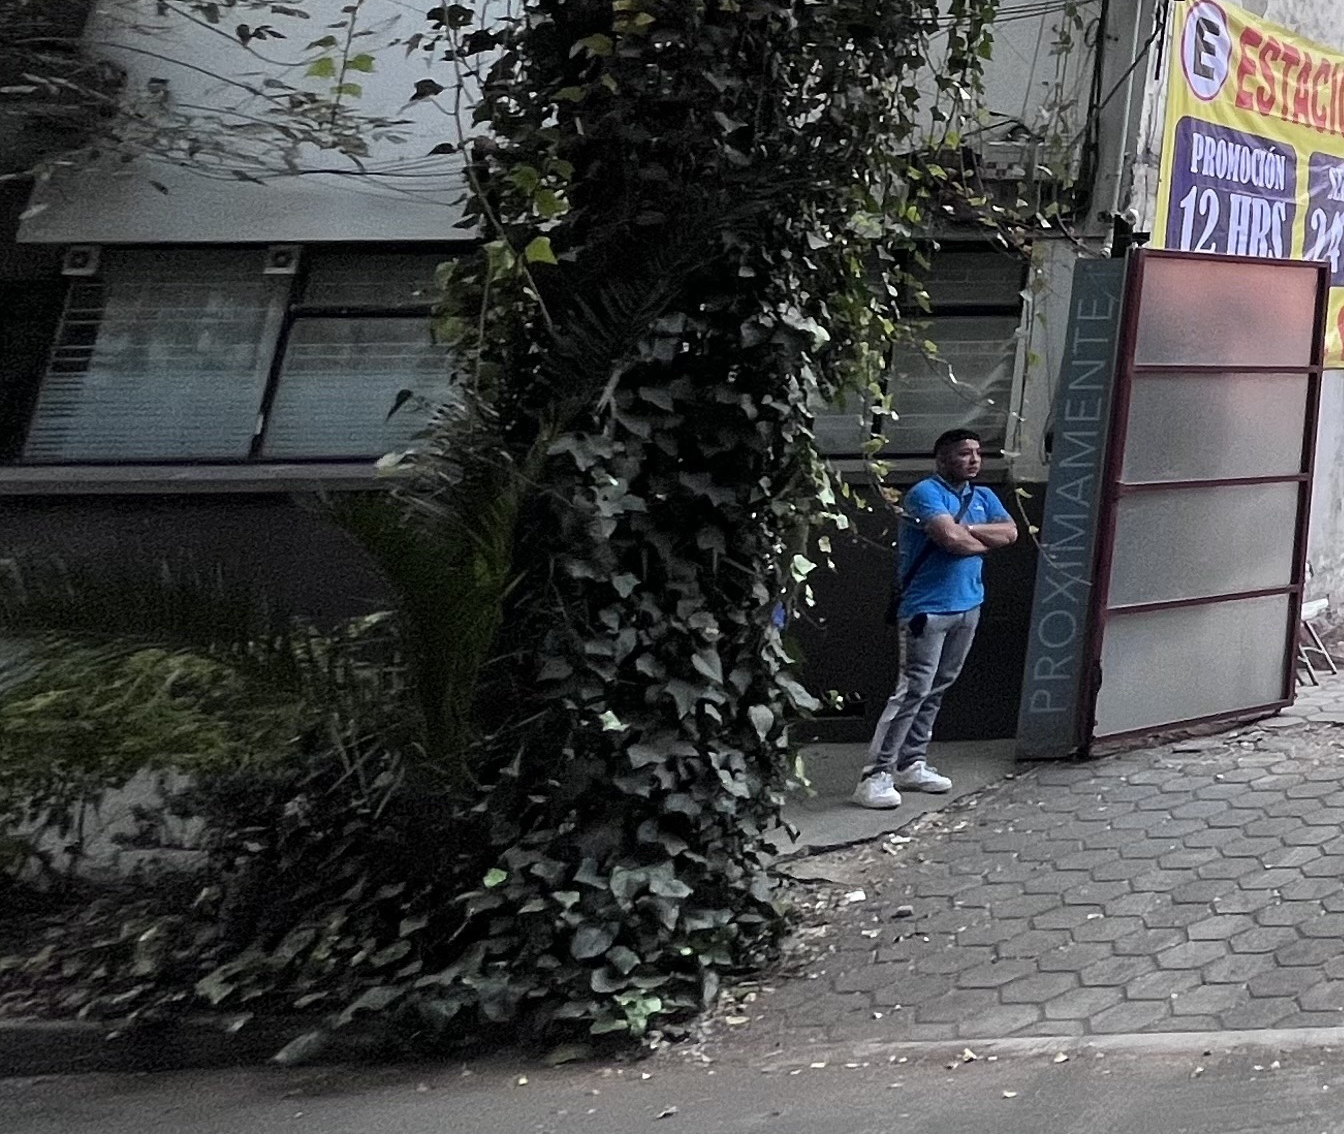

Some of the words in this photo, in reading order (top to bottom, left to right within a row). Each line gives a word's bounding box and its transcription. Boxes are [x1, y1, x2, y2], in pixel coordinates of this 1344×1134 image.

[1193, 17, 1221, 81] E
[1190, 132, 1286, 191] PROMOCIÓN
[1180, 185, 1220, 254] 12
[1227, 193, 1286, 259] HRS
[1311, 207, 1344, 274] 24
